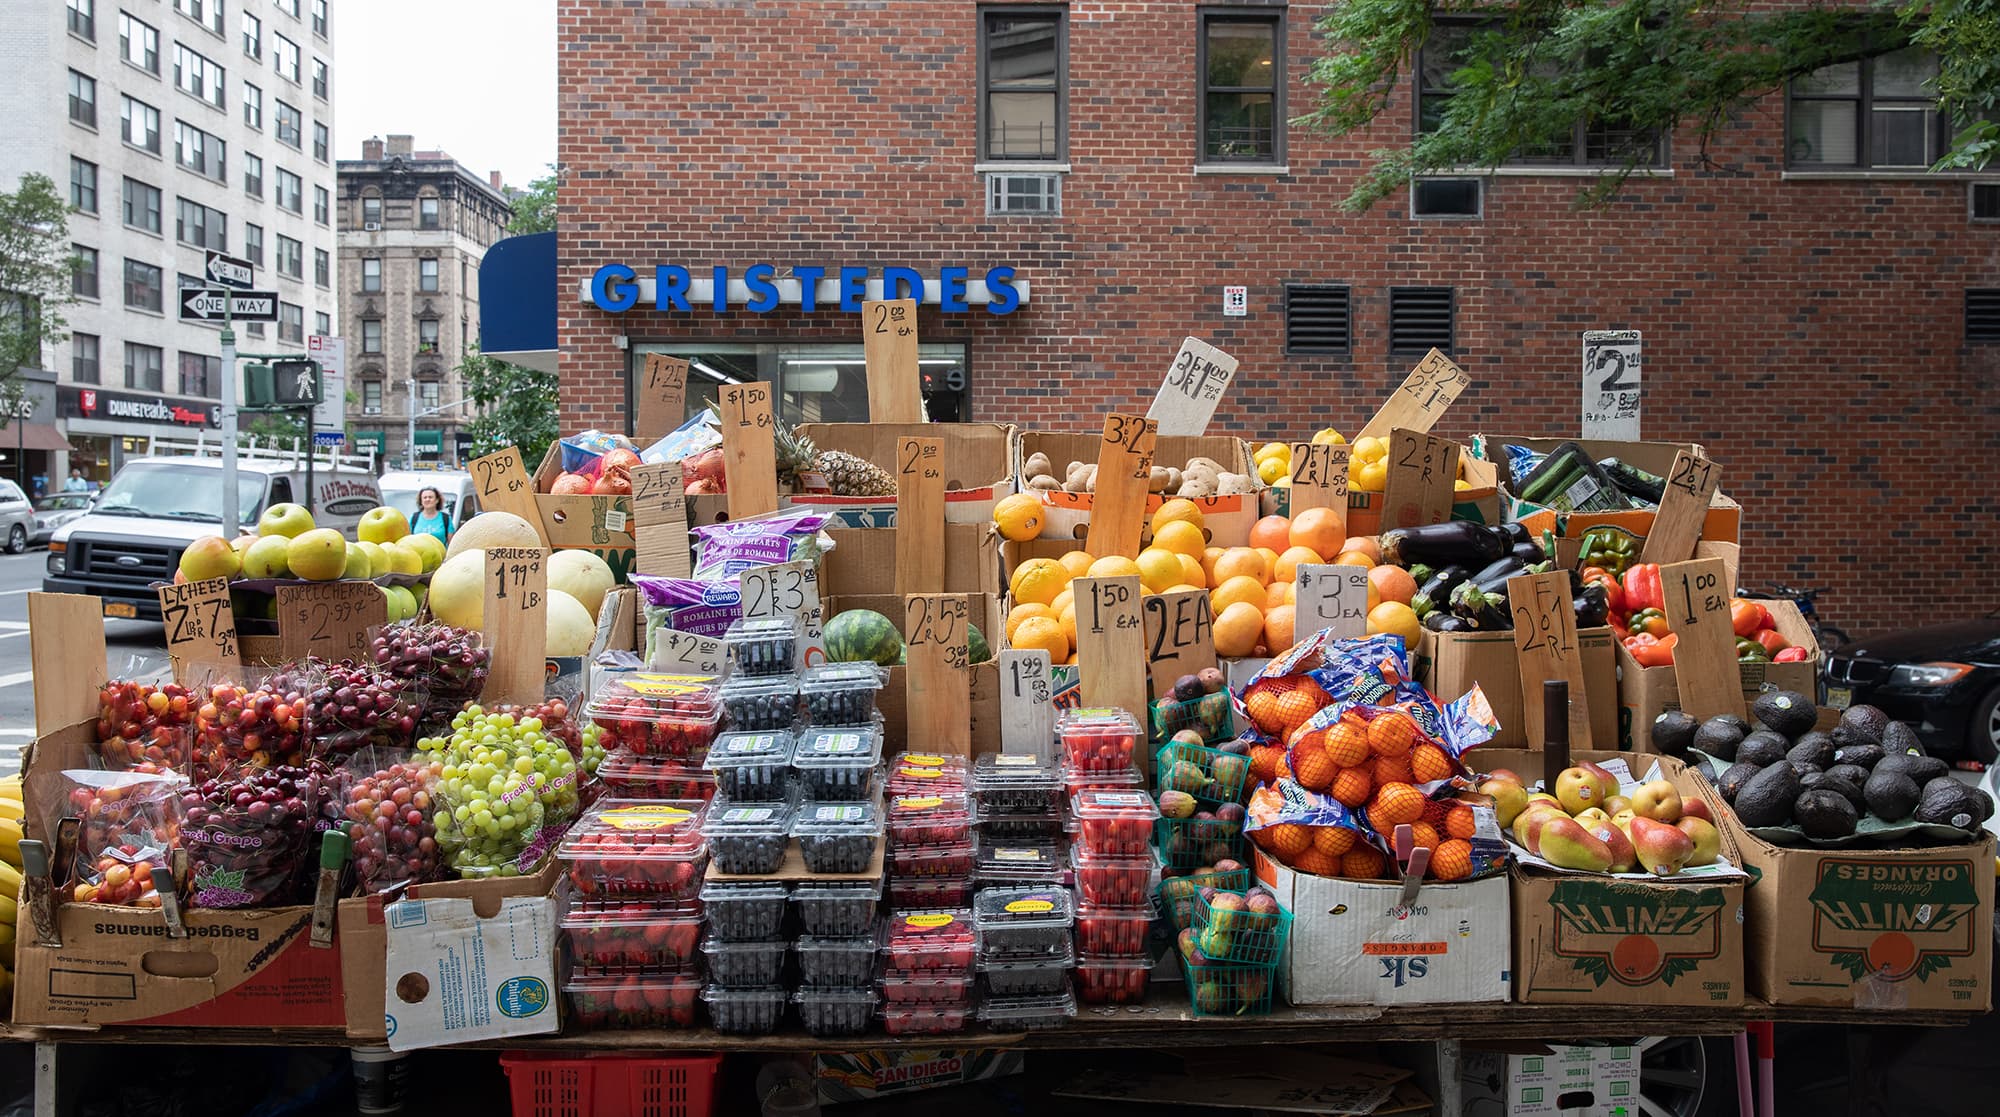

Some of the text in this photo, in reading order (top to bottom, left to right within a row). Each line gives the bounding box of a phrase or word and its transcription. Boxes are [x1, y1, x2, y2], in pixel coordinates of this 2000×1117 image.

[212, 261, 249, 280] ONE WAY
[591, 263, 1018, 316] GRISTEDES
[195, 299, 266, 312] ONE WAY
[1400, 436, 1419, 468] 2
[747, 538, 781, 548] HEARTS
[745, 548, 779, 559] ROMAINE
[163, 579, 226, 607] LYCHEES
[321, 583, 382, 604] CHERRIES
[705, 592, 738, 602] REWARD
[747, 574, 767, 617] 2
[683, 608, 728, 624] ROMAINE
[907, 596, 928, 647] 2
[1343, 607, 1364, 620] EA
[717, 622, 728, 631] DE
[1517, 606, 1545, 652] 2
[502, 781, 529, 805] Fresh
[214, 831, 263, 849] Grape
[1836, 865, 1958, 881] ORANGES
[1872, 880, 1933, 897] California
[1408, 905, 1429, 917] OAK
[1554, 902, 1722, 933] ZENITH
[179, 924, 260, 942] Bagged
[1372, 944, 1437, 952] ORANGES
[1702, 981, 1731, 991] ORANGES
[1947, 978, 1978, 987] ORANGES
[506, 979, 522, 1016] Chiquita
[1710, 991, 1728, 1000] NAVEL
[874, 1058, 962, 1084] SAN DIEGO
